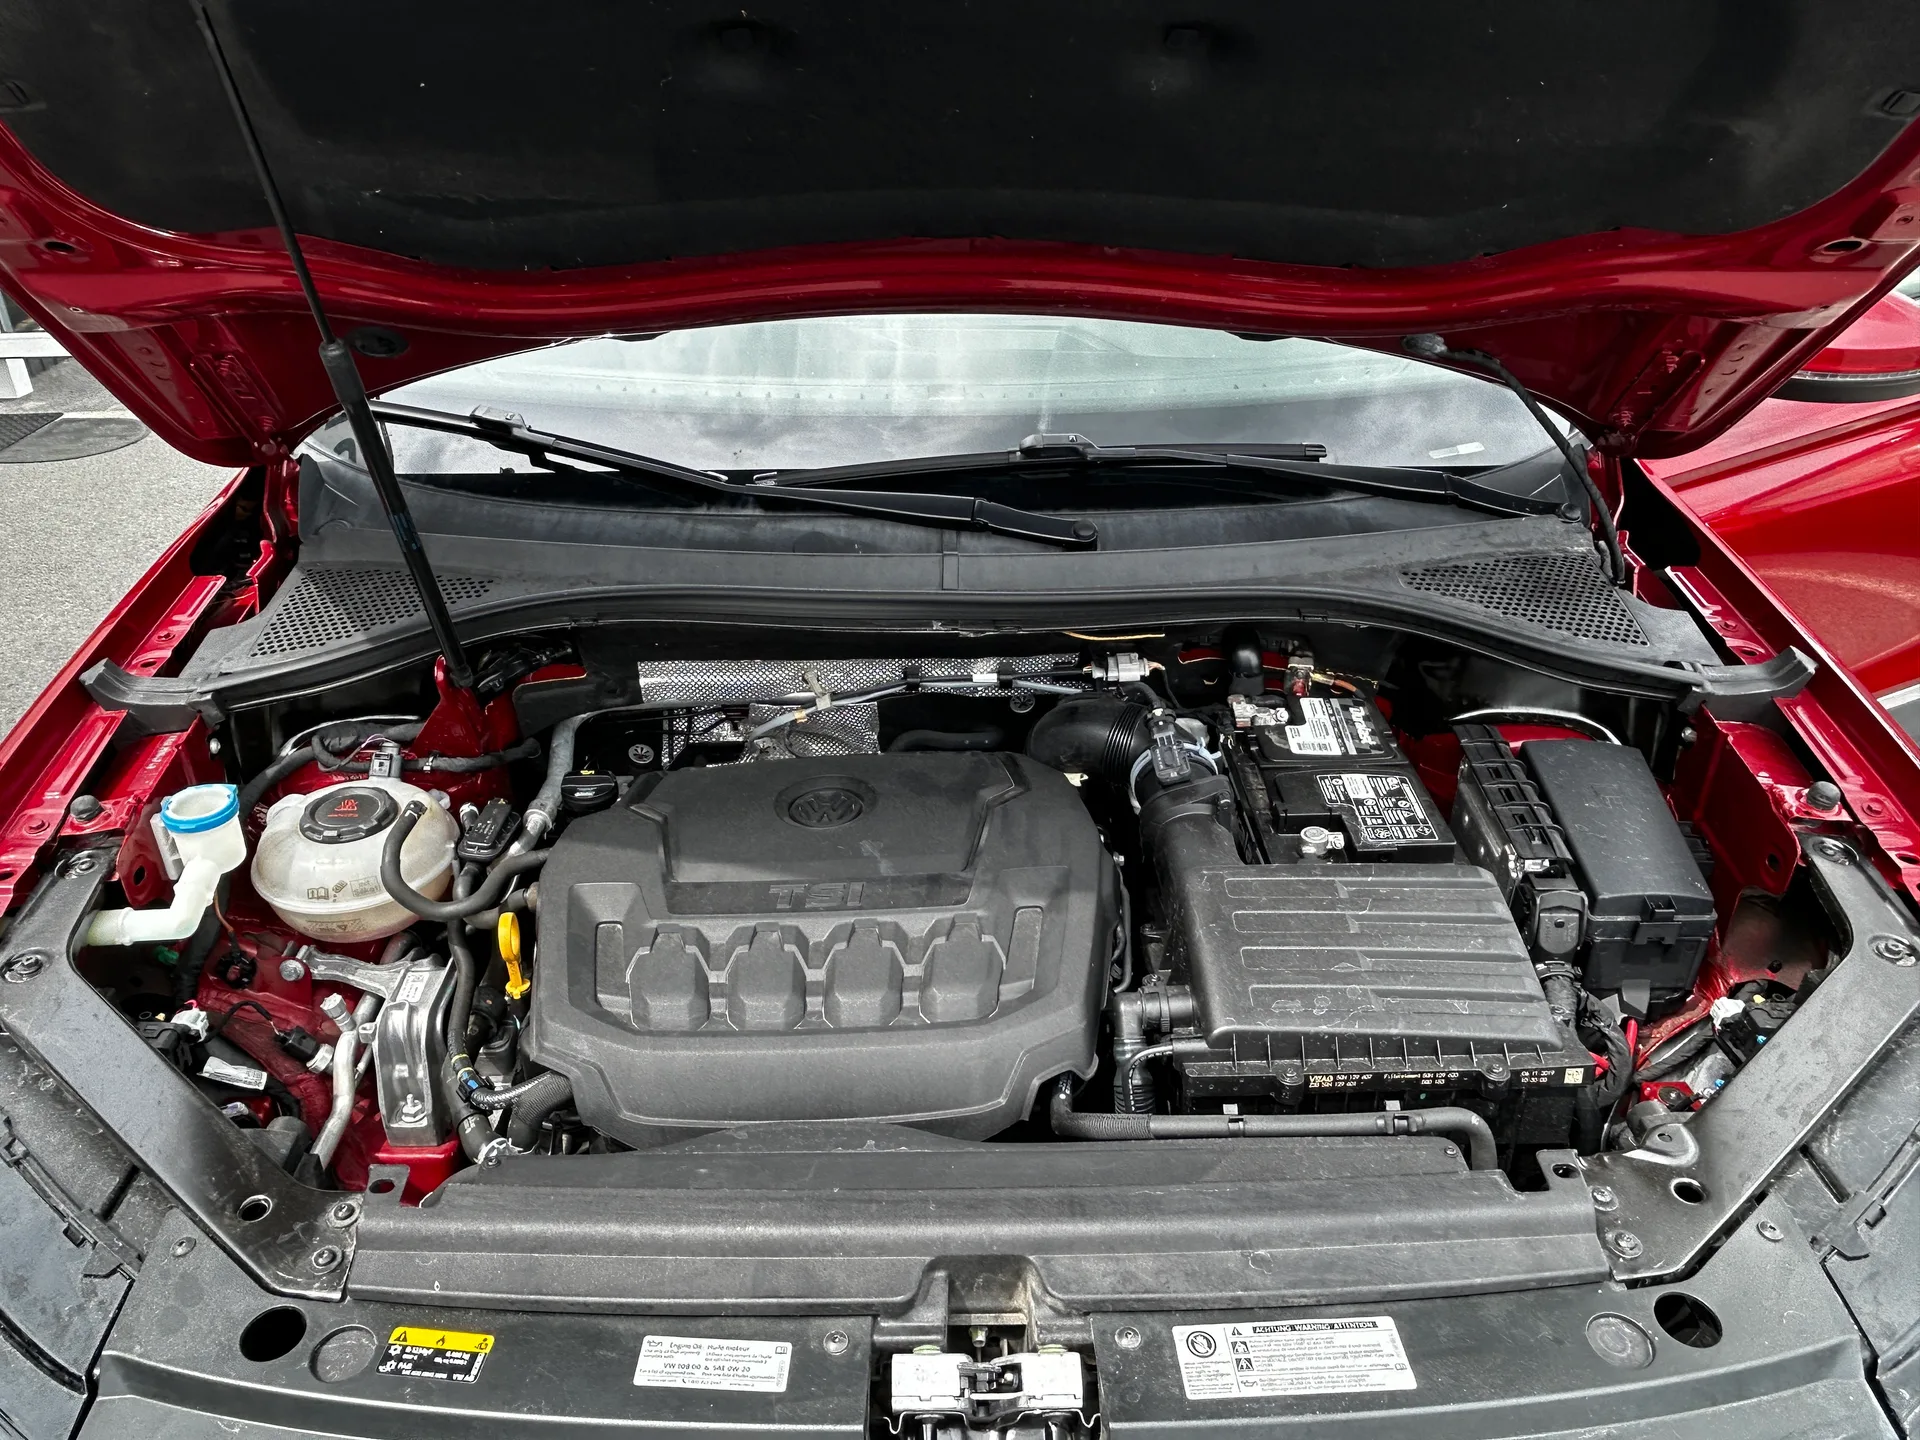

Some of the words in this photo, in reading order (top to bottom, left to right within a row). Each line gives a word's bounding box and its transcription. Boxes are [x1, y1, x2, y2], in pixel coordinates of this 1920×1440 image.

[769, 881, 866, 908] TSI
[1256, 1324, 1291, 1333] ACHTUNG
[1295, 1323, 1330, 1332] WARNING
[1334, 1321, 1374, 1330] ATTENTION
